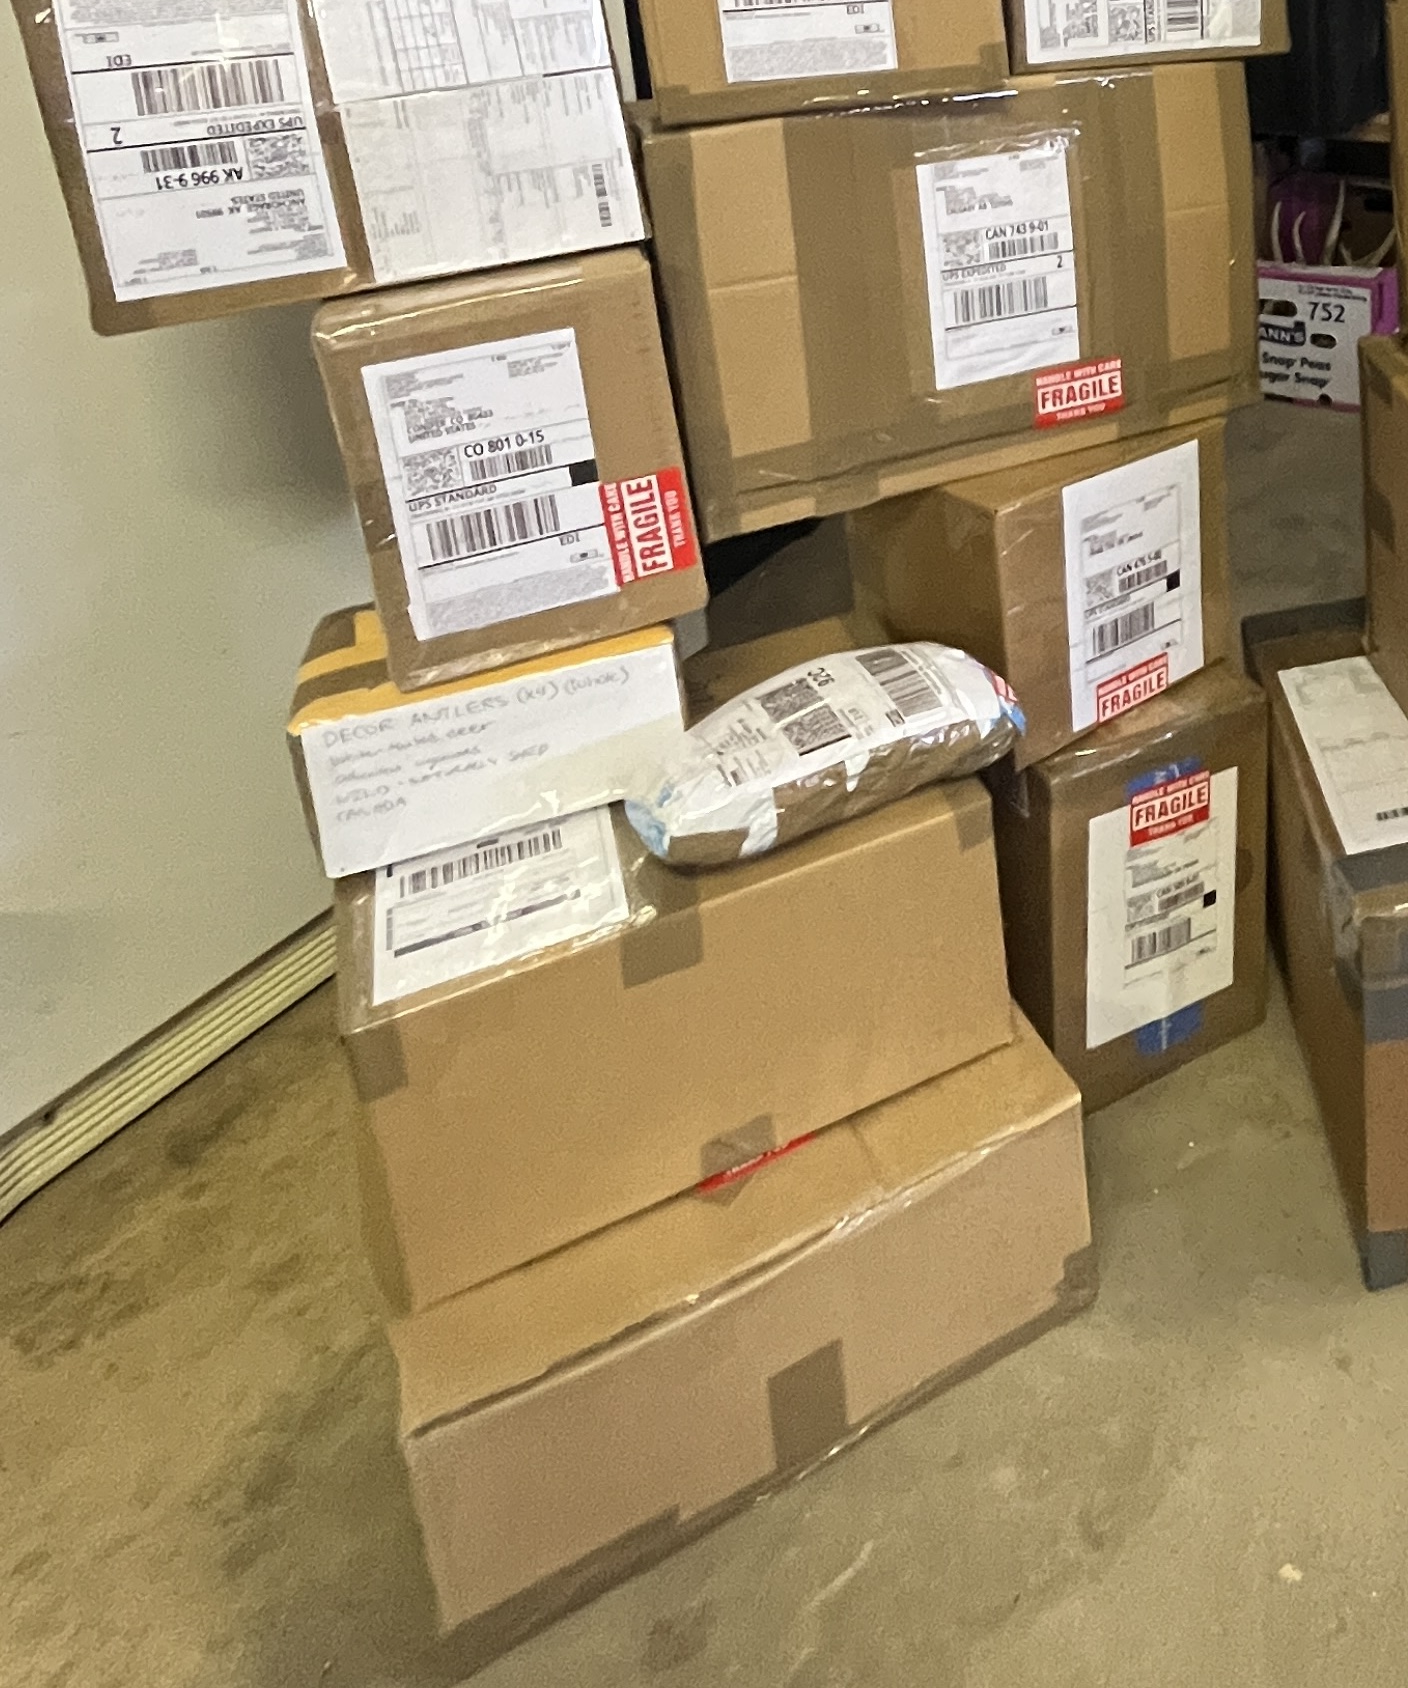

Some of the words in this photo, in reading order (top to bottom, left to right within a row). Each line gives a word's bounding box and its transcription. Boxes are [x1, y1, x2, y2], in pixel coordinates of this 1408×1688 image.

[206, 118, 275, 136] EXPEDITED
[278, 115, 303, 128] UPS
[110, 126, 123, 145] 2
[155, 173, 188, 190] 9-31
[191, 169, 220, 185] 996
[223, 166, 243, 181] AK
[985, 226, 1006, 240] CAN
[1010, 223, 1027, 237] 743
[1028, 220, 1048, 234] 9-01
[1057, 255, 1063, 268] 2
[1308, 302, 1345, 323] 752
[1260, 326, 1304, 343] ANN'S
[1300, 357, 1332, 372] Peas
[1041, 375, 1119, 409] FRAGILE
[464, 443, 484, 458] CO
[488, 437, 511, 453] 801
[515, 430, 545, 447] 0-15
[409, 500, 432, 512] UPS
[434, 484, 497, 507] STANDARD
[604, 482, 621, 512] CARE
[626, 479, 668, 572] FRAGILE
[559, 533, 581, 547] EDI
[1102, 671, 1164, 717] FRAGILE
[322, 718, 394, 748] DECOR
[411, 695, 509, 727] ANTLERS
[1135, 785, 1207, 827] FRAGILE
